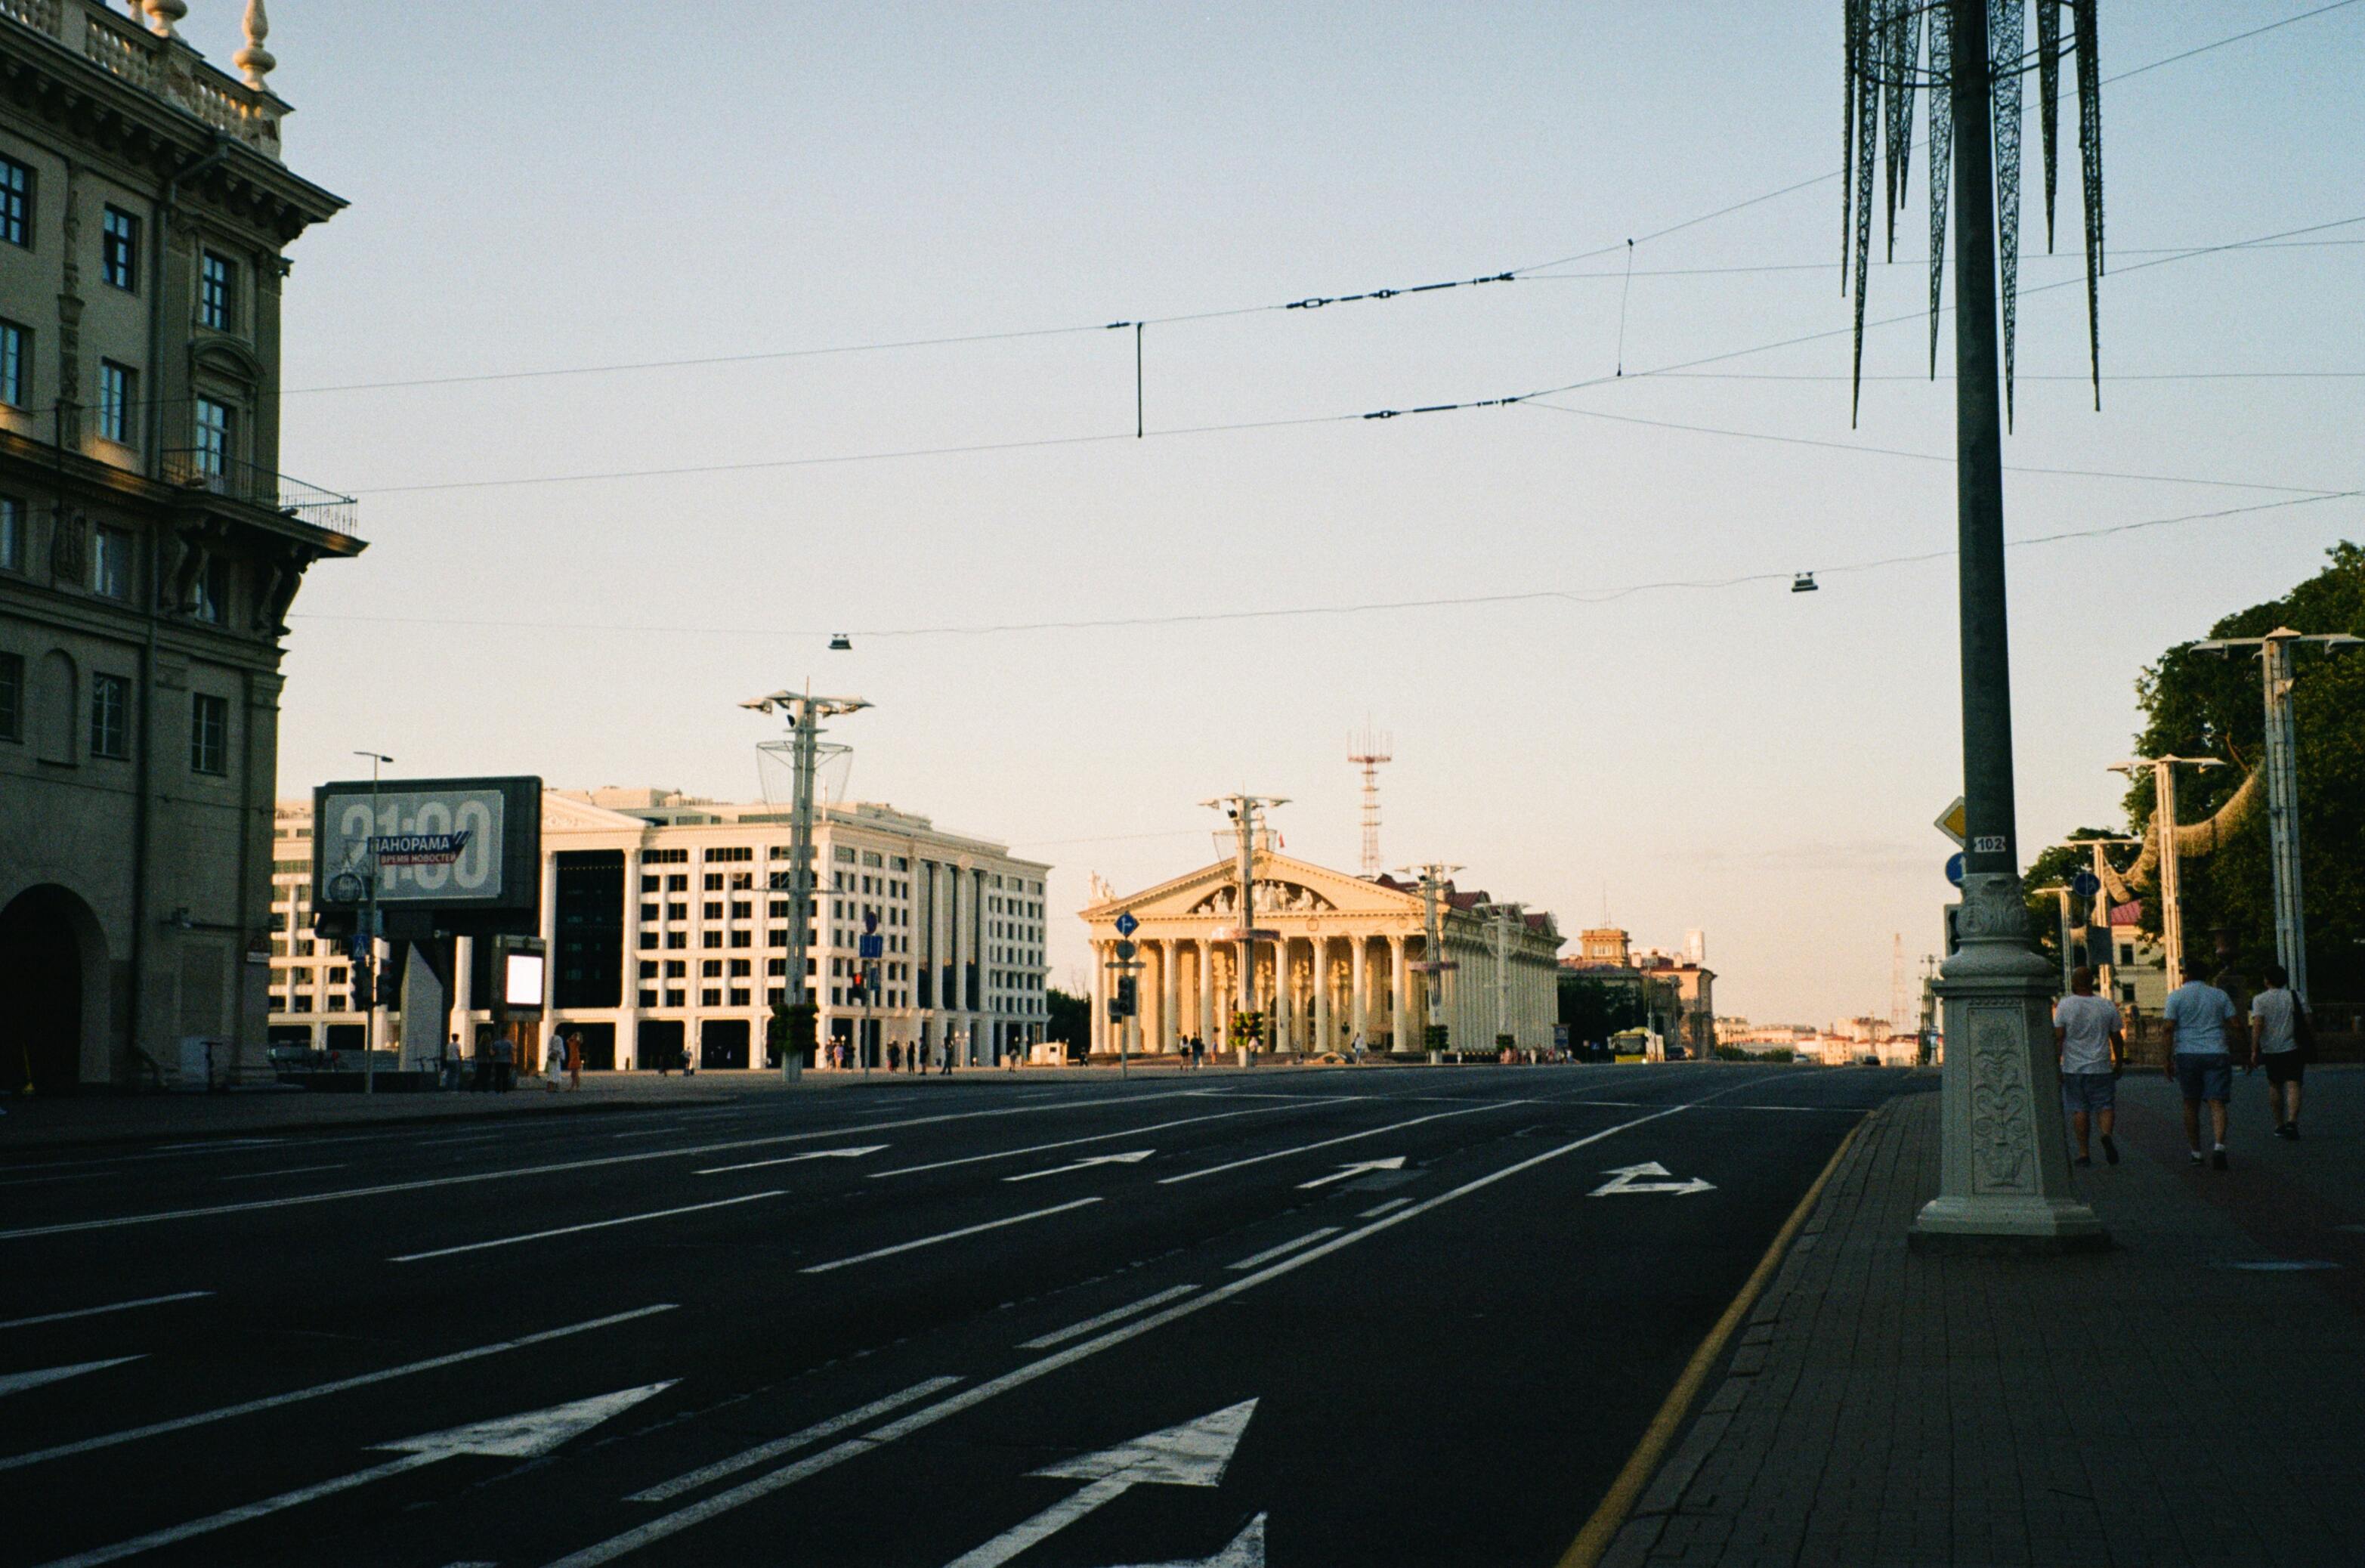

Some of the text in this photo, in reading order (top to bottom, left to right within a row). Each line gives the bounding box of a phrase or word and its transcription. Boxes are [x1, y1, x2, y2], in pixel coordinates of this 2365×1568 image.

[1978, 838, 2003, 850] 102
[381, 852, 456, 864] ВРЕМЯ НОВОСТЕЙ
